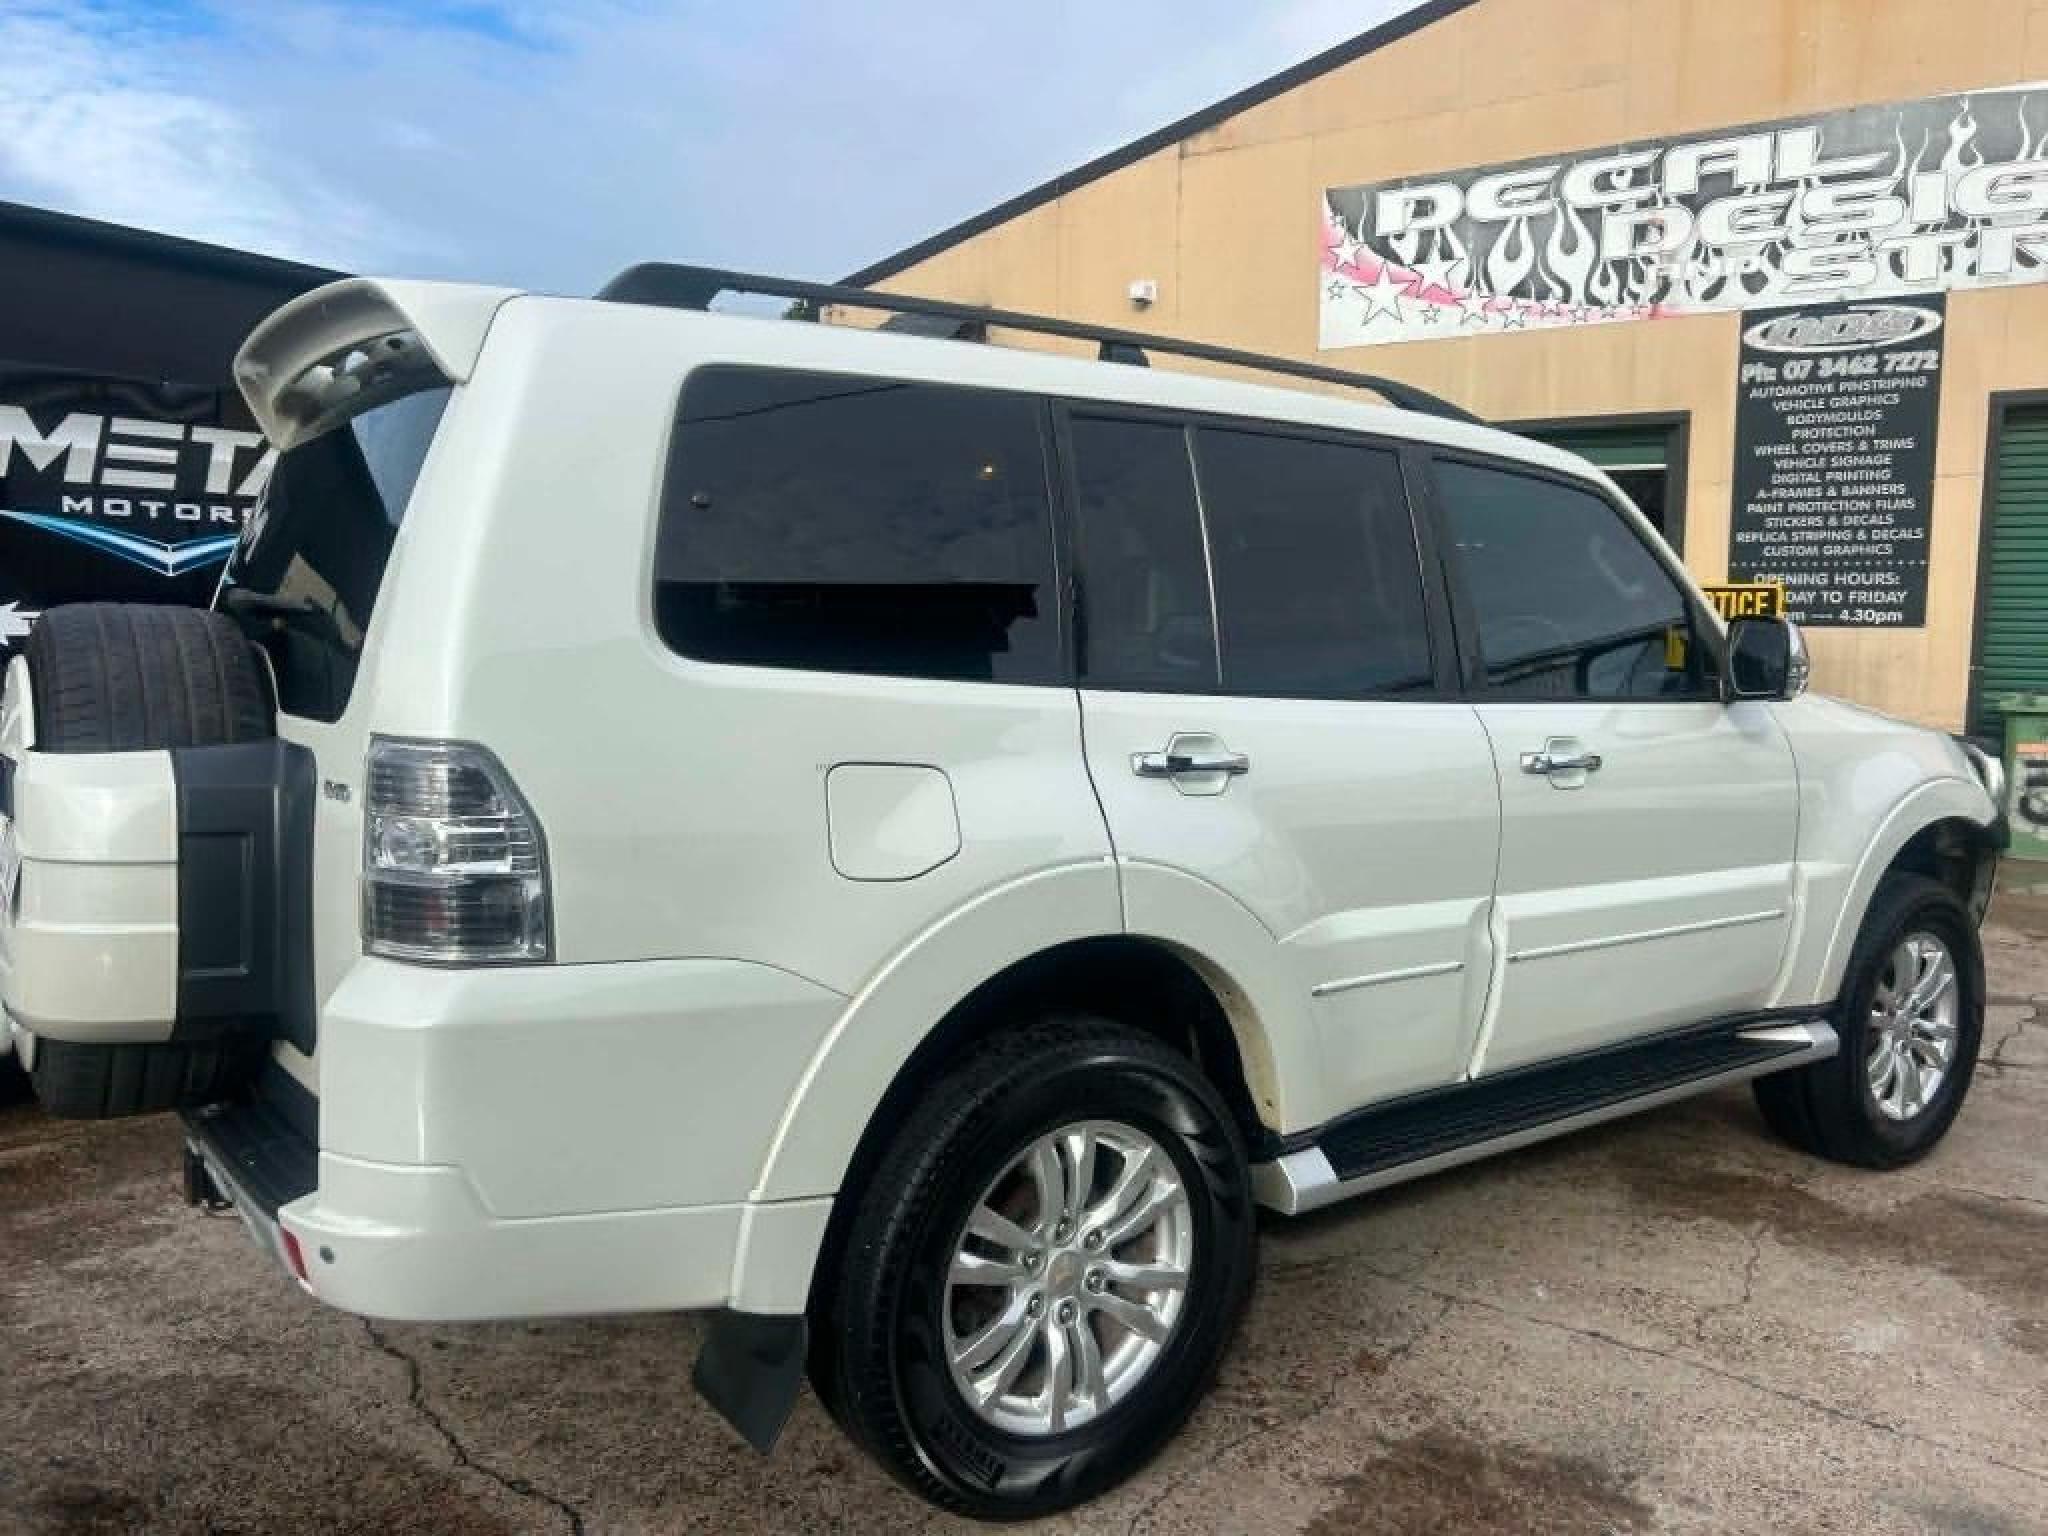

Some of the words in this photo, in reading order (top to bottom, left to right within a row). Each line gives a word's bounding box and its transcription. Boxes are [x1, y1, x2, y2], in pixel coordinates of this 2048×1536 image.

[1376, 125, 1890, 236] DECAL
[1782, 360, 1815, 380] 07
[1750, 383, 1835, 399] AUTOMOTIVE
[1839, 376, 1927, 393] PINSTRIPING
[1772, 398, 1825, 411] VEHICLE
[1830, 393, 1899, 408] GRAPHICS
[1787, 410, 1883, 425] BODYMOULDS
[1792, 424, 1876, 439] PROTECTION
[1754, 444, 1798, 457] WHEEL
[1802, 441, 1854, 454] COVERS
[1858, 440, 1869, 451] &
[1874, 437, 1915, 449] TRIMS
[1774, 458, 1826, 470] VEHICLE
[1831, 454, 1892, 468] SIGNAGE
[1772, 471, 1822, 484] DIGITAL
[1825, 469, 1891, 482] PRINTING
[1756, 486, 1822, 499] A-FRAMES
[1826, 485, 1837, 496] &
[1842, 483, 1907, 496] BANNERS
[1748, 502, 1784, 513] PAINT
[1788, 500, 1871, 513] PROTECTION
[1876, 497, 1917, 510] FILMS
[1765, 515, 1823, 528] STICKERS
[1828, 515, 1839, 527] &
[1843, 513, 1895, 525] DECALS
[1736, 530, 1787, 543] REPLICA
[1792, 529, 1851, 542] STRIPING
[1857, 529, 1867, 541] &
[1871, 527, 1924, 540] DECALS
[1762, 545, 1819, 557] CUSTOM
[1823, 543, 1893, 556] GRAPHICS
[1753, 572, 1828, 585] OPENING
[1835, 571, 1901, 585] HOURS:
[1705, 591, 1769, 618] TICE
[1785, 591, 1817, 603] DAY
[1823, 591, 1843, 603] TO
[1848, 590, 1909, 603] FRIDAY
[1839, 609, 1903, 625] 4.30pm
